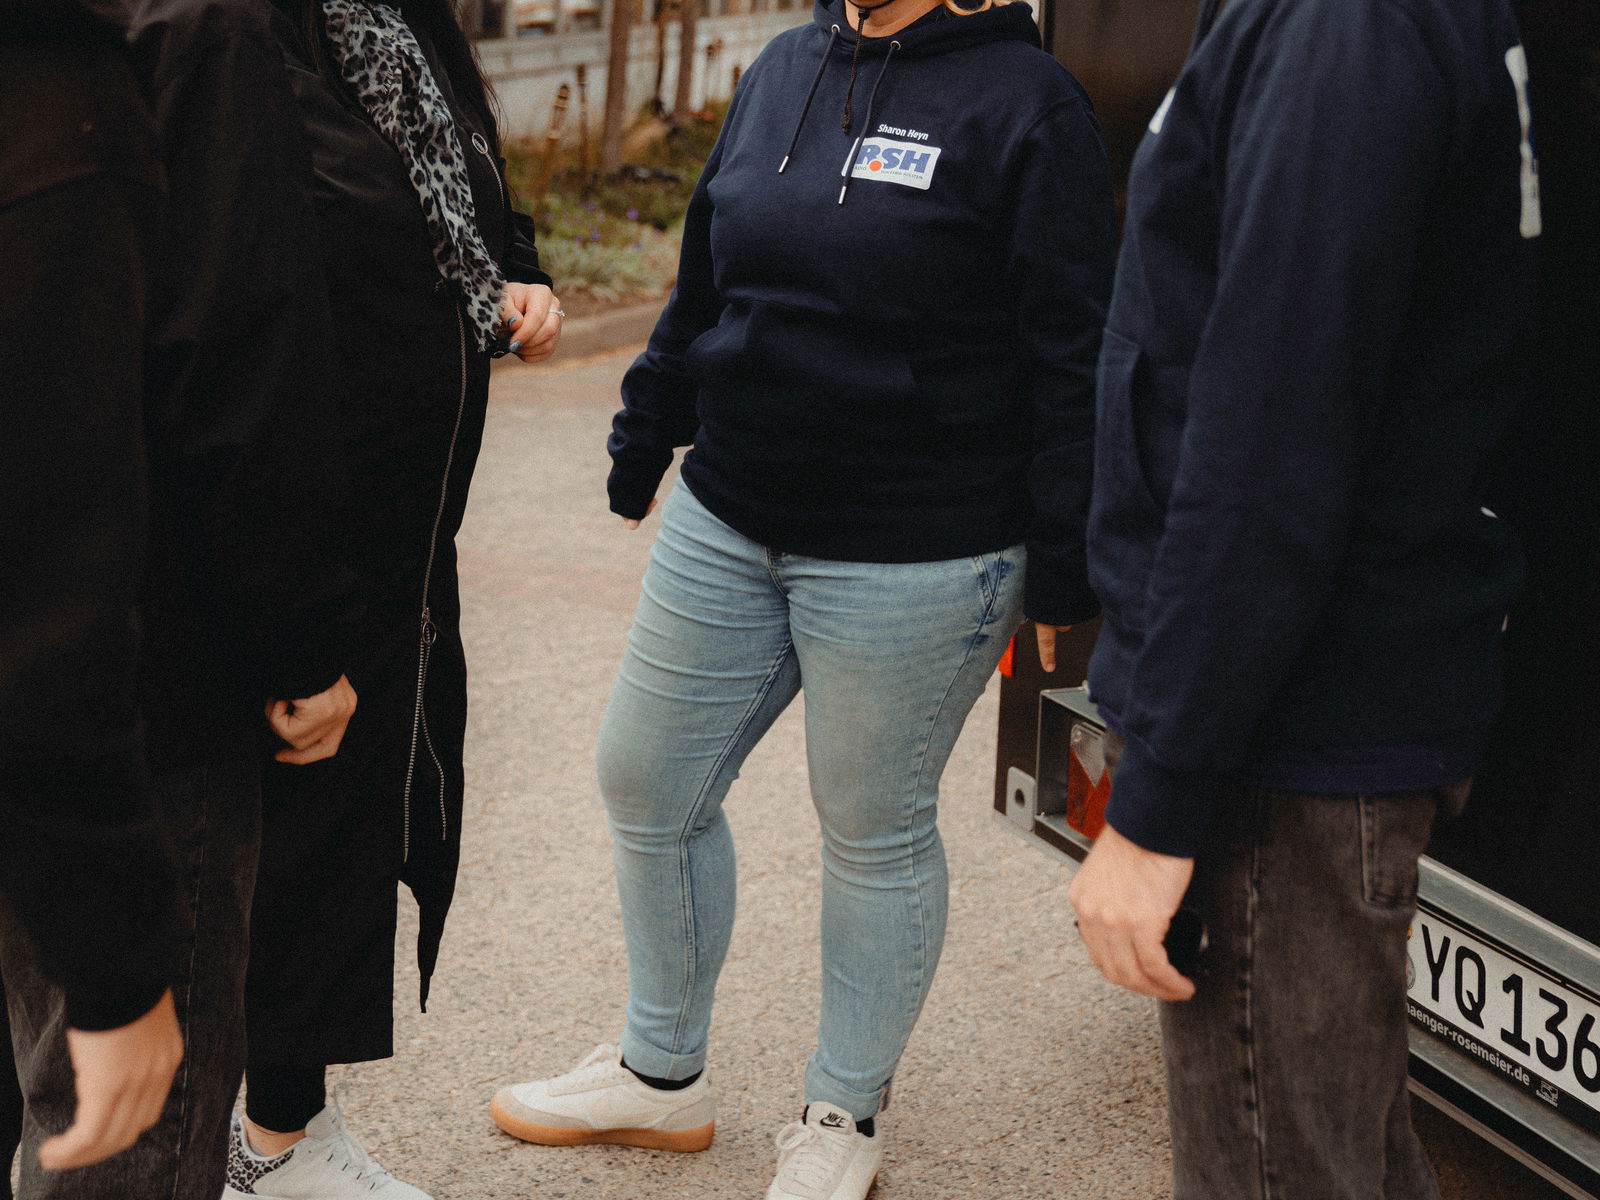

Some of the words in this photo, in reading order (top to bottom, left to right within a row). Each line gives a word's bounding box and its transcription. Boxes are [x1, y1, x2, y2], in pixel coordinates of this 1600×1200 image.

[877, 123, 907, 137] Sharon
[907, 128, 929, 141] Heyn
[855, 144, 932, 174] RSH
[1421, 923, 1487, 1030] YQ
[824, 1111, 848, 1125] NIKE
